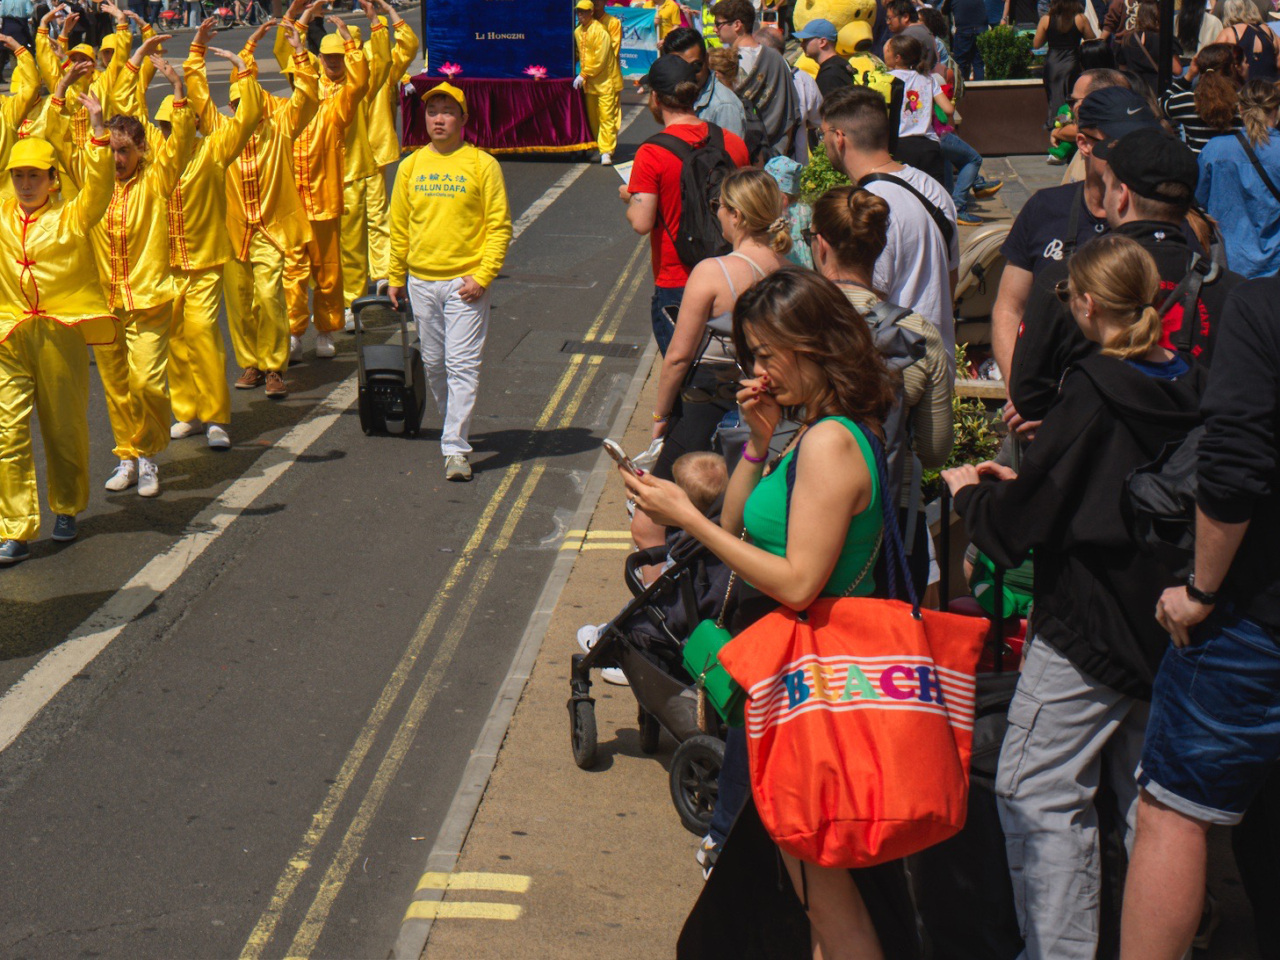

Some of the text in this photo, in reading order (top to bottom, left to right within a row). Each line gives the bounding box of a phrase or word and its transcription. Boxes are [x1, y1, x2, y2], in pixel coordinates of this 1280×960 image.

[416, 173, 467, 182] 法輪大法
[415, 184, 466, 193] FALUN DAFA
[782, 664, 944, 710] BEACH
